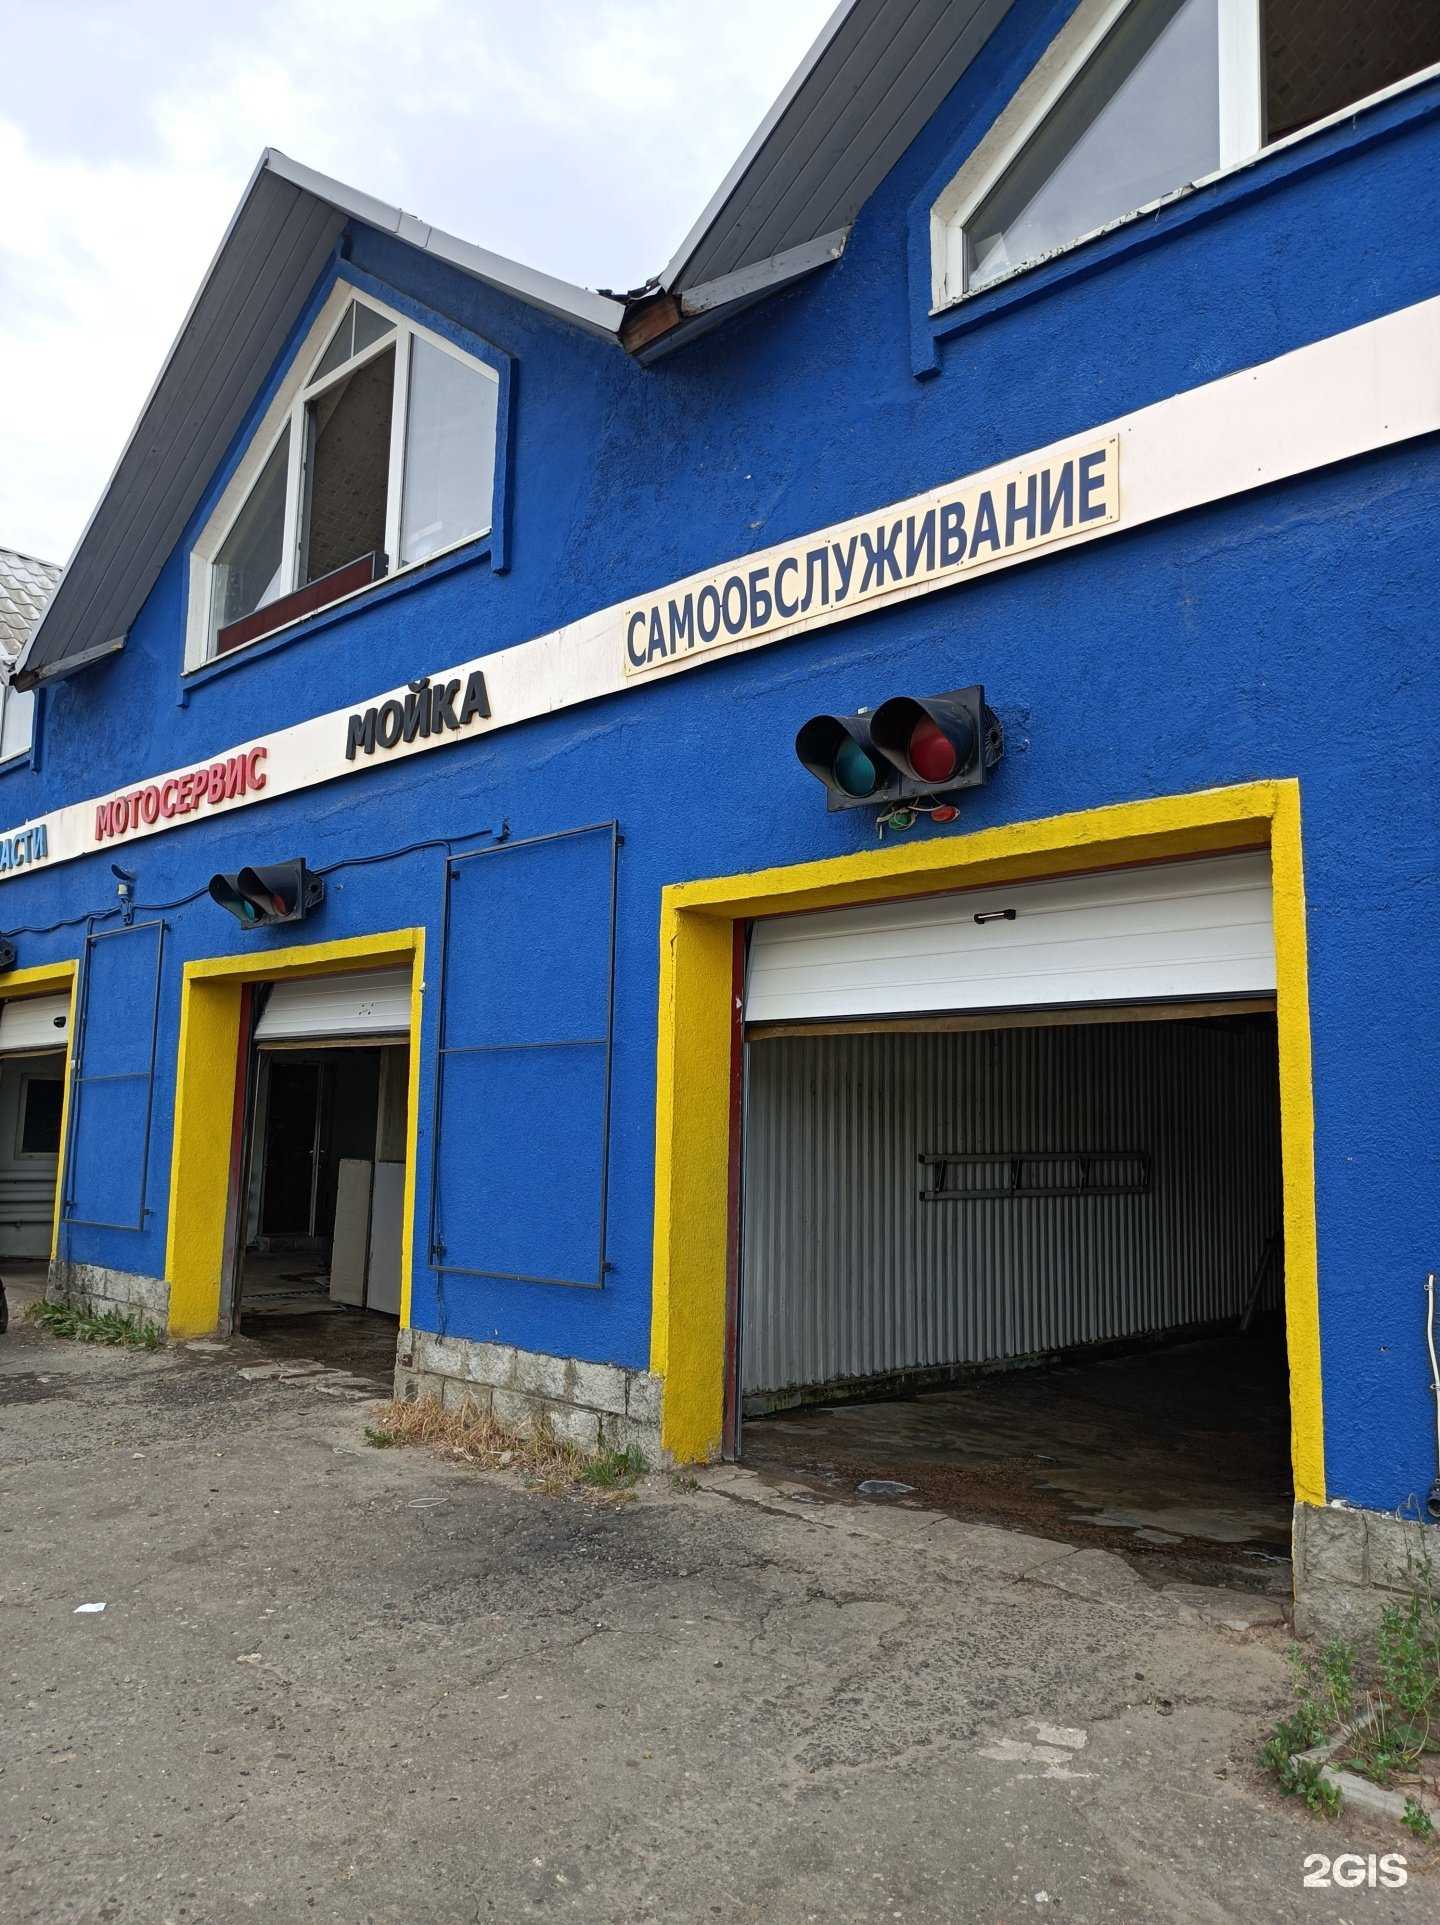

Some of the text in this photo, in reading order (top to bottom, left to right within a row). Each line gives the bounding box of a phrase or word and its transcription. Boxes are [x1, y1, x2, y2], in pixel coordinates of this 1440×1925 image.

[627, 449, 1106, 667] САМООБСЛУЖИВАНИЕ
[345, 670, 491, 760] МОЙКА
[94, 747, 267, 841] МОТОСЕРВИС
